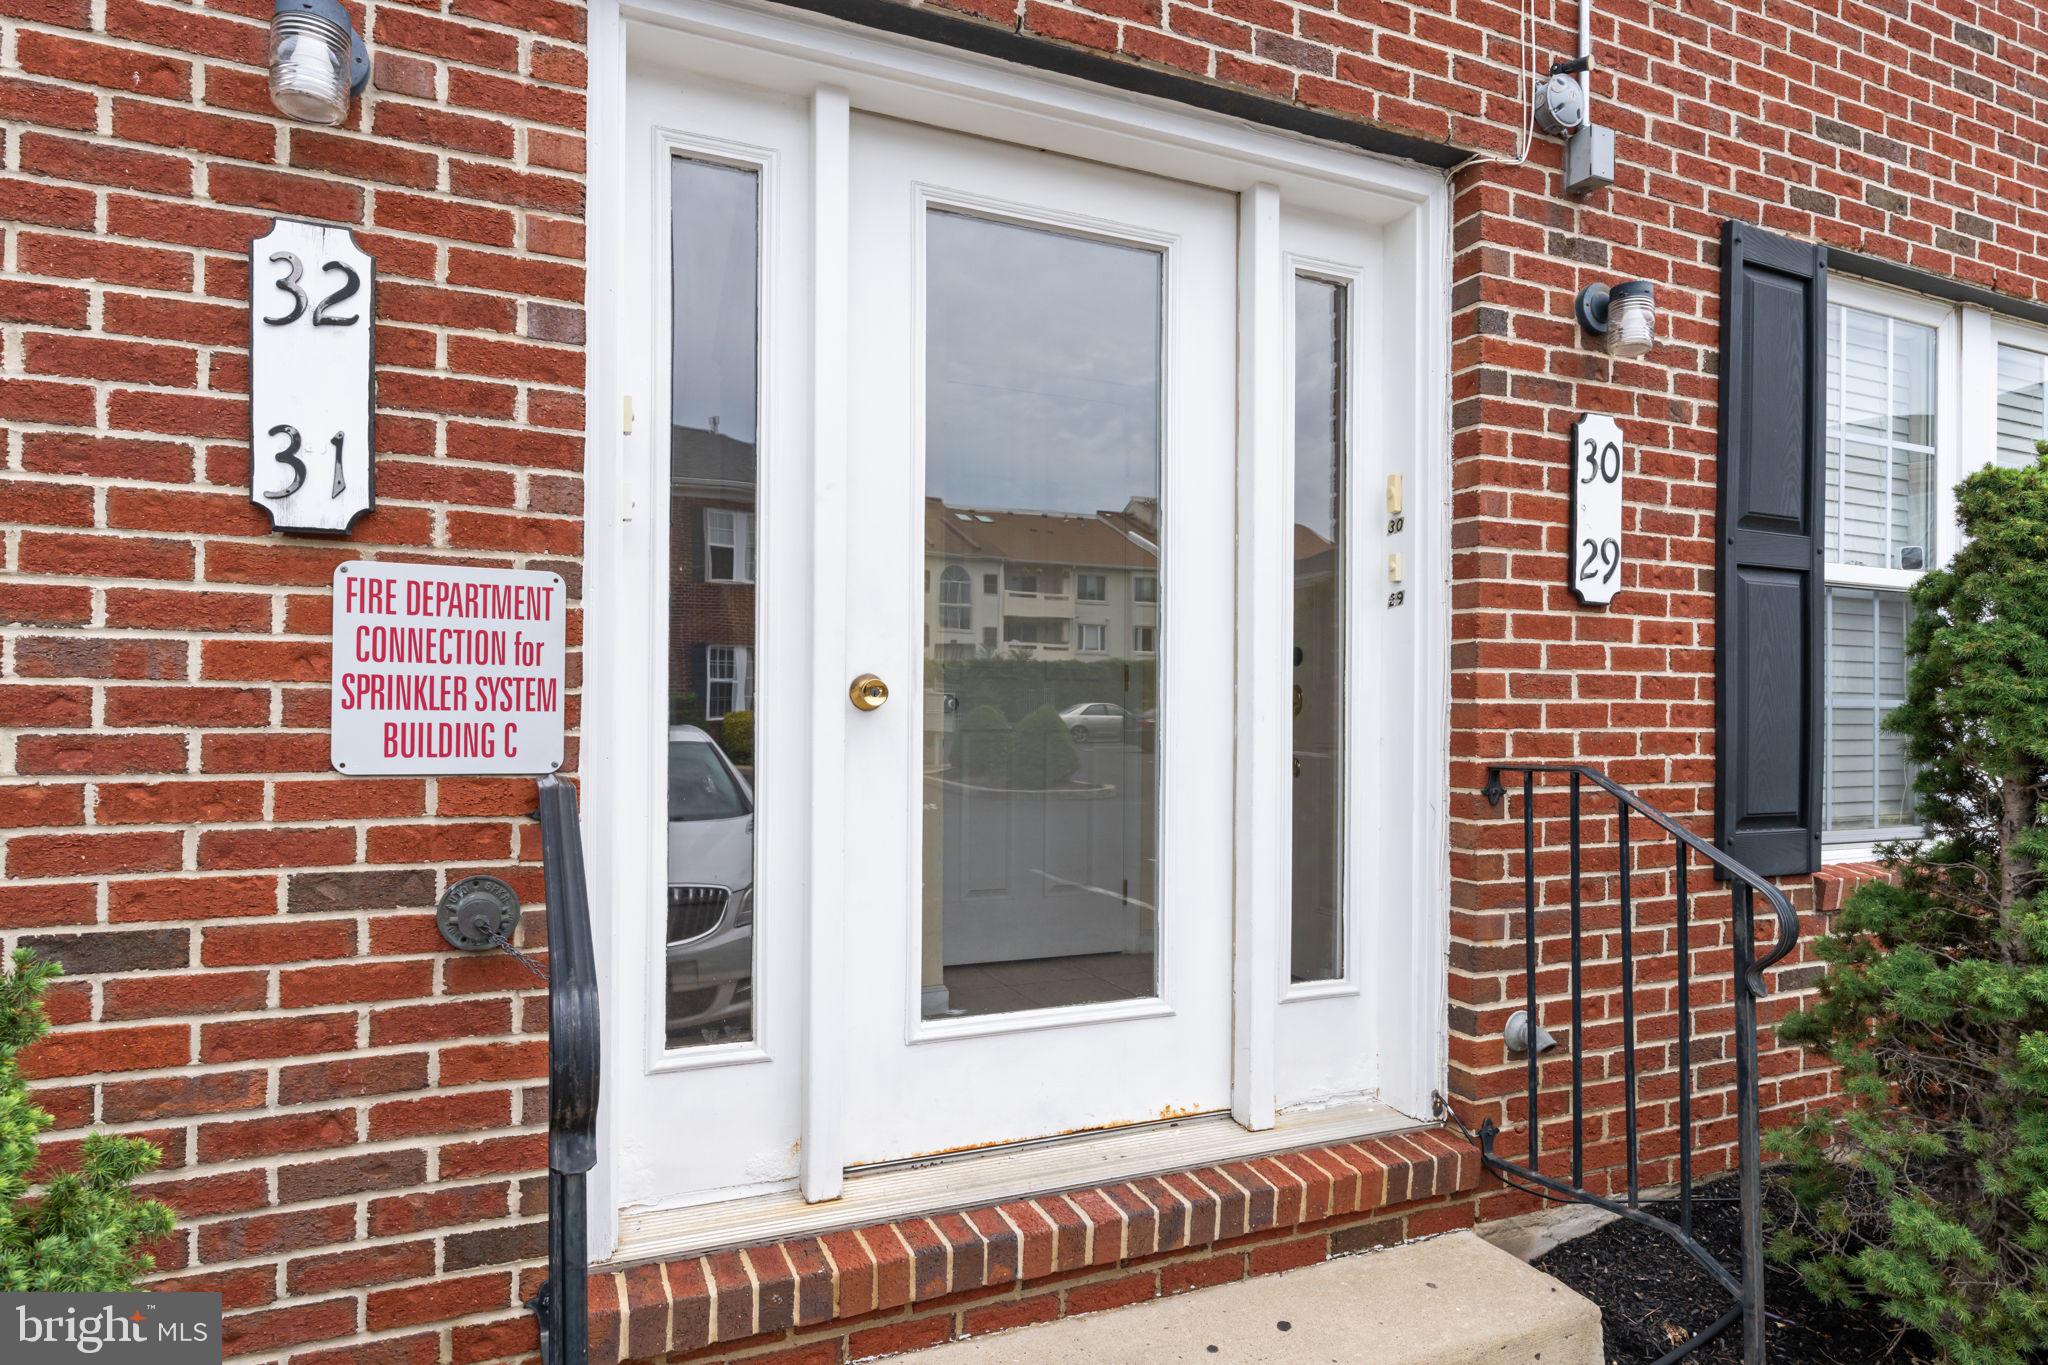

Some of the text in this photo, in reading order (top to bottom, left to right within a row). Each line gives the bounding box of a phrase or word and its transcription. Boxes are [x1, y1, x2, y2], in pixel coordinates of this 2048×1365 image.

[263, 251, 360, 326] 32
[263, 424, 346, 499] 31
[1581, 438, 1621, 483] 30
[1387, 519, 1404, 534] 30
[1580, 537, 1620, 584] 29
[346, 577, 554, 621] FIRE DEPARTMENT
[355, 626, 544, 666] CONNECTION for
[341, 673, 557, 712] SPRINKLER SYSTEM
[383, 722, 518, 758] BUILDING C
